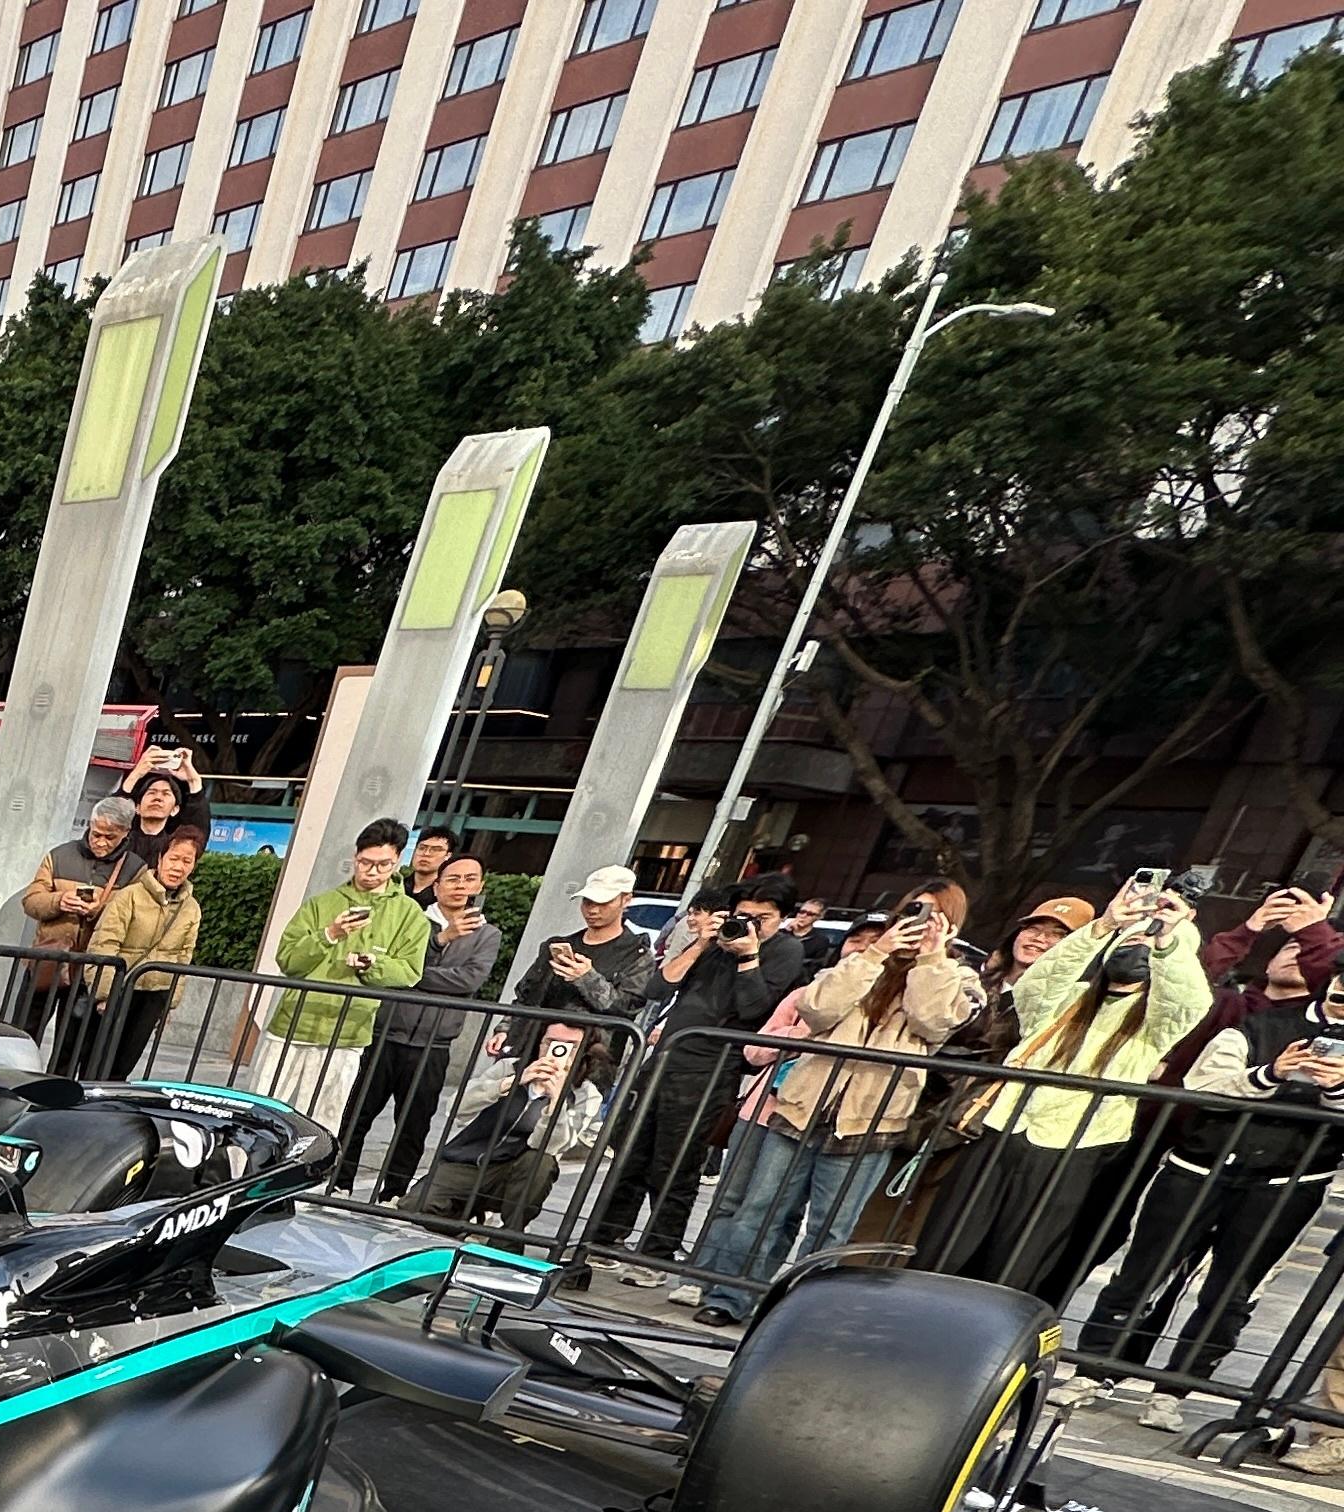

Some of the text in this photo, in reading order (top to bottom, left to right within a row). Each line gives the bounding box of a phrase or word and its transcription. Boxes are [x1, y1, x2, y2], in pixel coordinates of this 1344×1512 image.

[151, 734, 249, 743] STARKS CFEE
[155, 1203, 210, 1244] AMD
